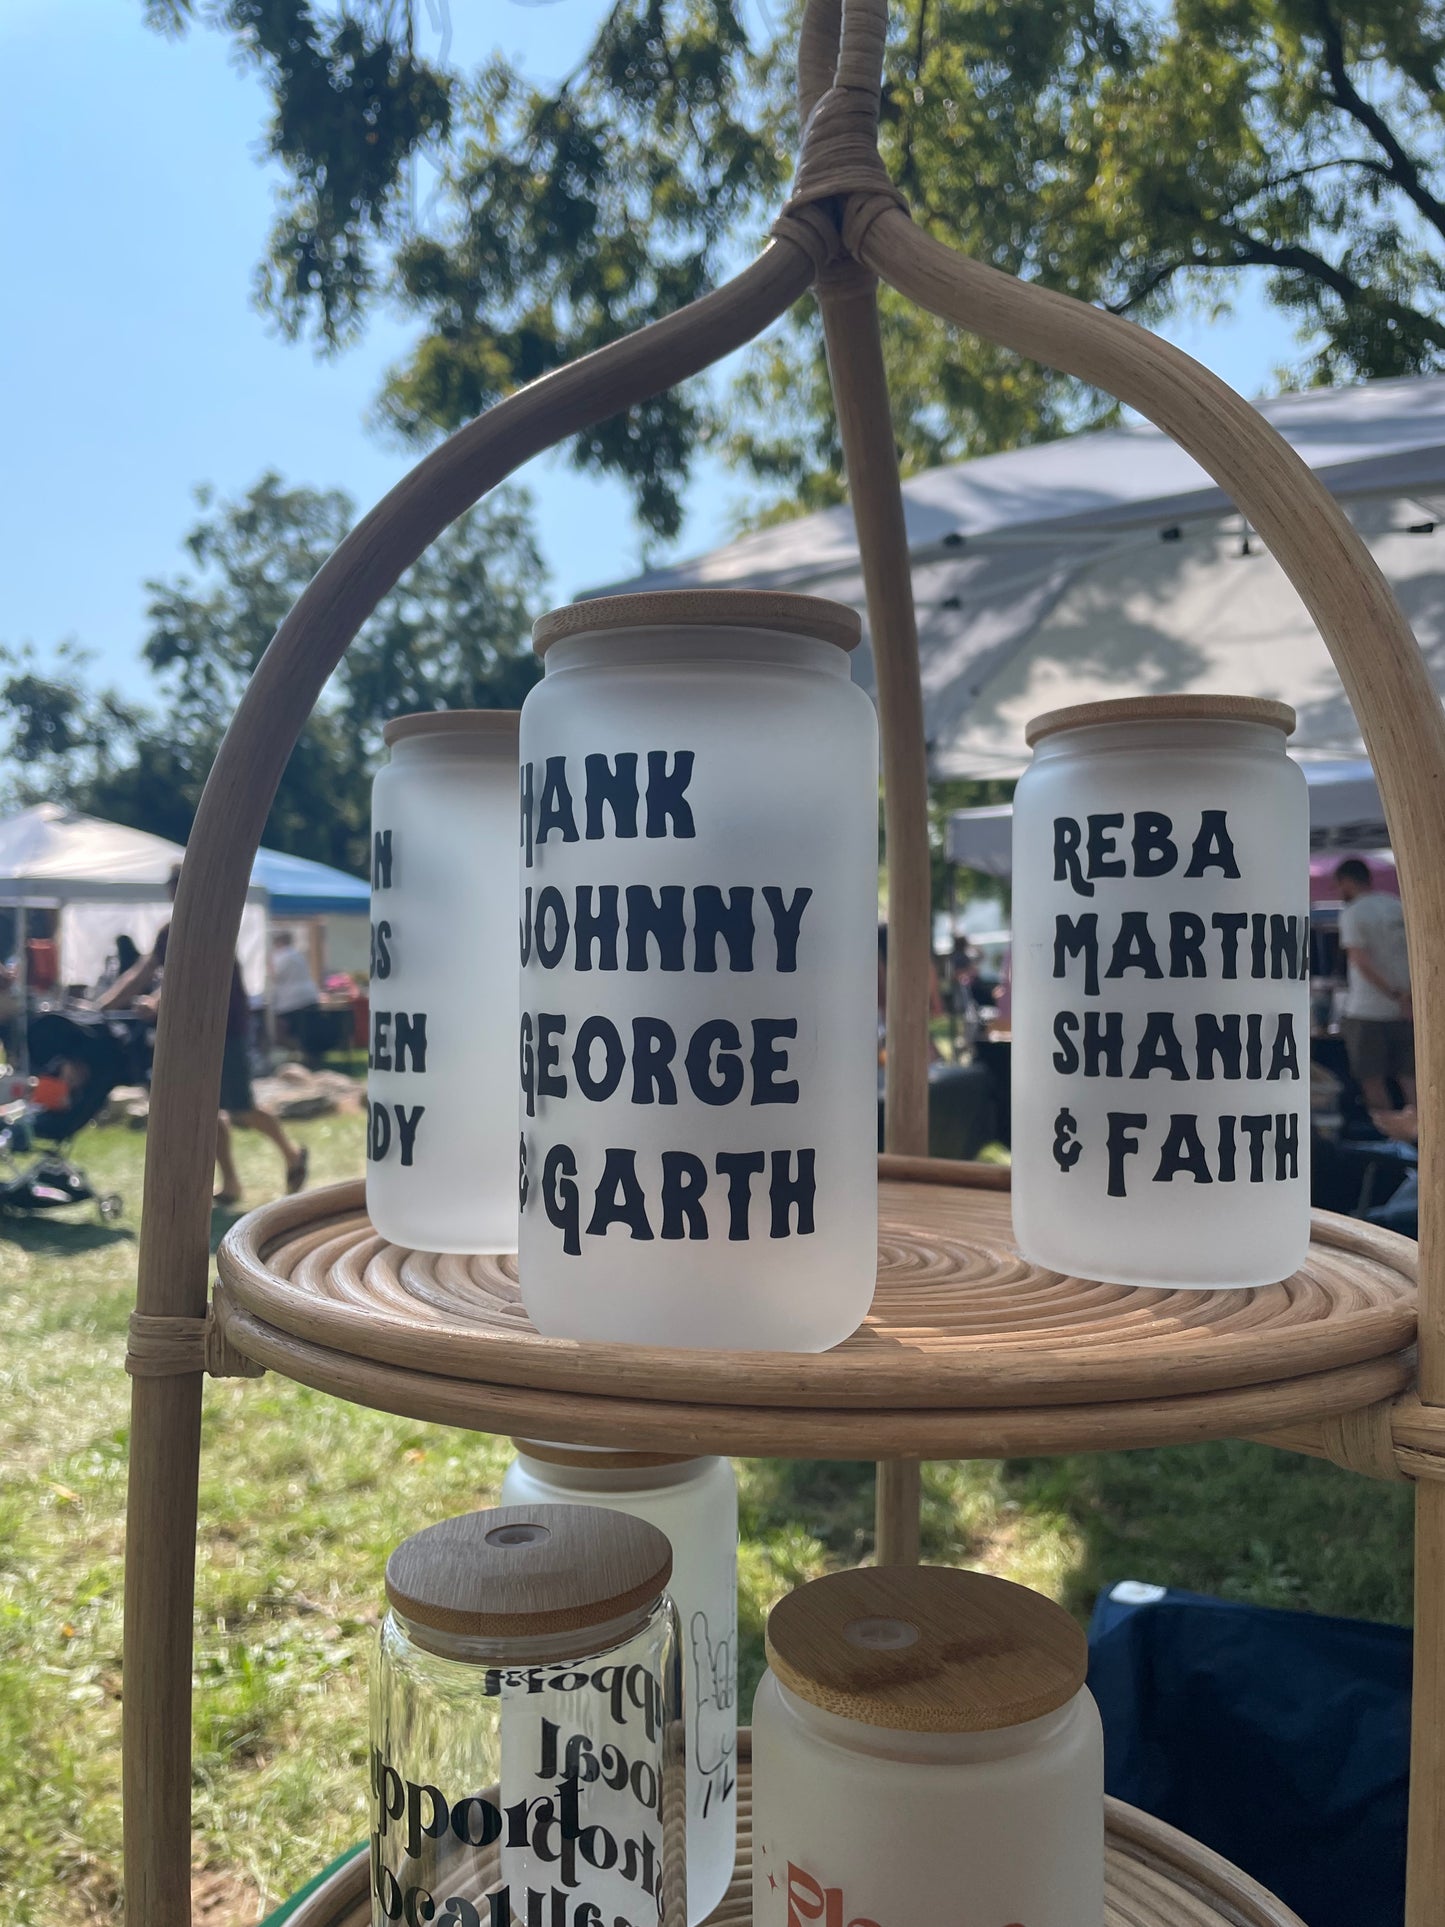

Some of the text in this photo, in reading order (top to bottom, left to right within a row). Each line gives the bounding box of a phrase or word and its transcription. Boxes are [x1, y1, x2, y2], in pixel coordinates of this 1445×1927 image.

[520, 751, 697, 868] HANK
[1053, 810, 1242, 898] REBA
[519, 885, 814, 973] JOHNNY
[519, 1011, 800, 1118] GEORGE
[1053, 1011, 1301, 1081] SHANIA
[541, 1143, 817, 1256] GARTH
[1053, 1107, 1299, 1197] & FAITH
[371, 1745, 585, 1860] pport
